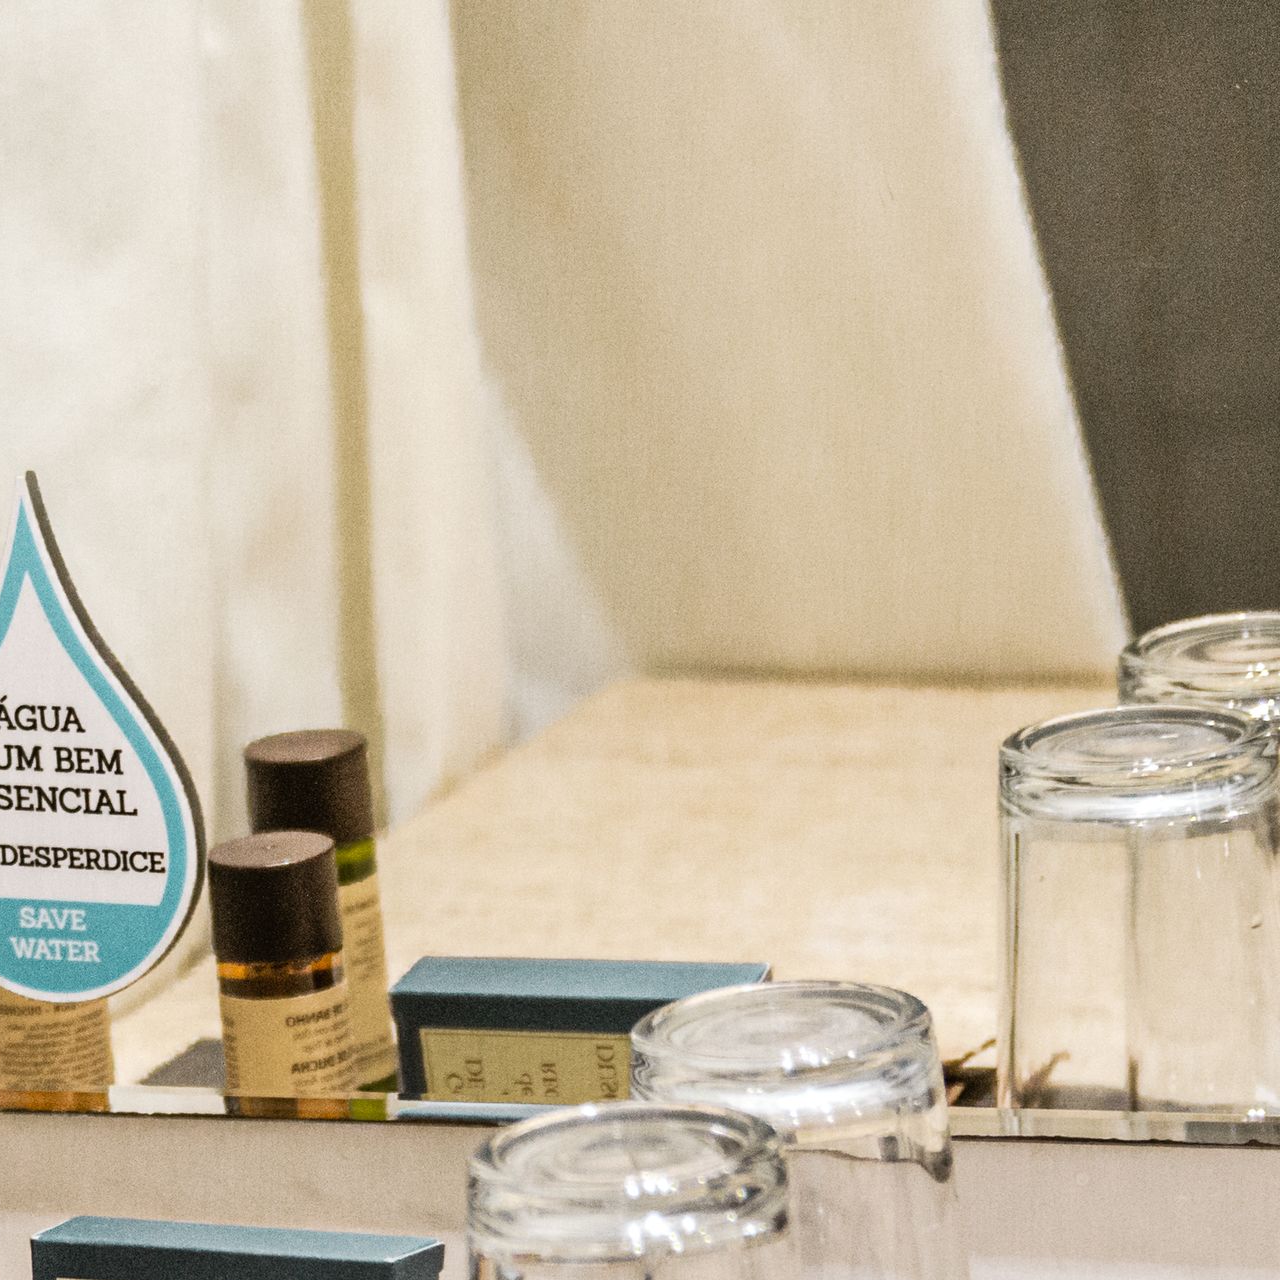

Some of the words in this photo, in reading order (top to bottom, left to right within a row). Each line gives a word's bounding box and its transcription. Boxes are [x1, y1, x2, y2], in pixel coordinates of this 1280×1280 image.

[54, 747, 124, 776] BEM
[18, 906, 87, 932] SAVE
[8, 935, 101, 964] WATER
